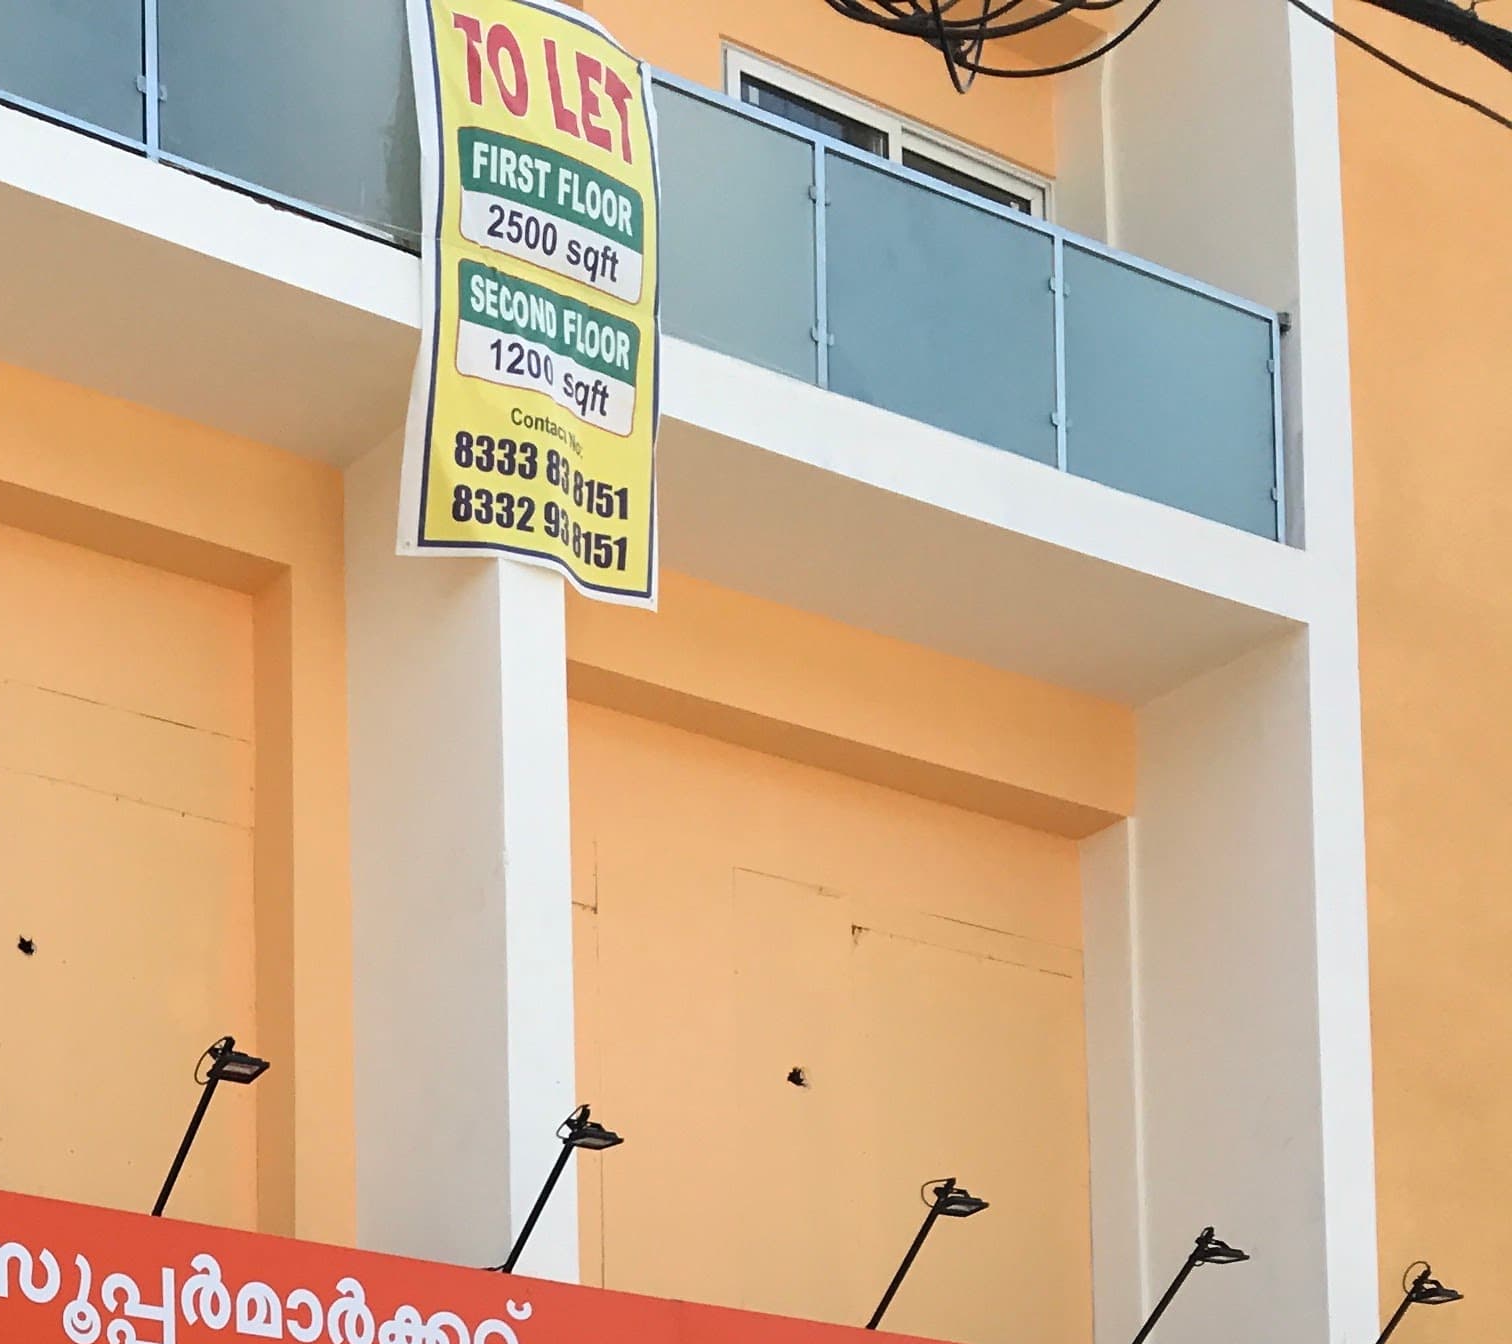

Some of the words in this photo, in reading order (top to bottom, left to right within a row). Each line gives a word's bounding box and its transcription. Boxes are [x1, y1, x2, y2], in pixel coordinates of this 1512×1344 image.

[453, 11, 529, 119] TO
[543, 39, 632, 164] LET
[472, 140, 551, 185] FIRST
[558, 165, 632, 236] FLOOR
[487, 204, 557, 258] 2500
[566, 233, 618, 283] sqft
[469, 274, 557, 339] SECOND
[563, 310, 630, 370] FLOOR
[489, 340, 554, 386] 1200
[563, 372, 609, 417] sqft
[454, 430, 538, 480] 8333
[452, 484, 535, 533] 8332
